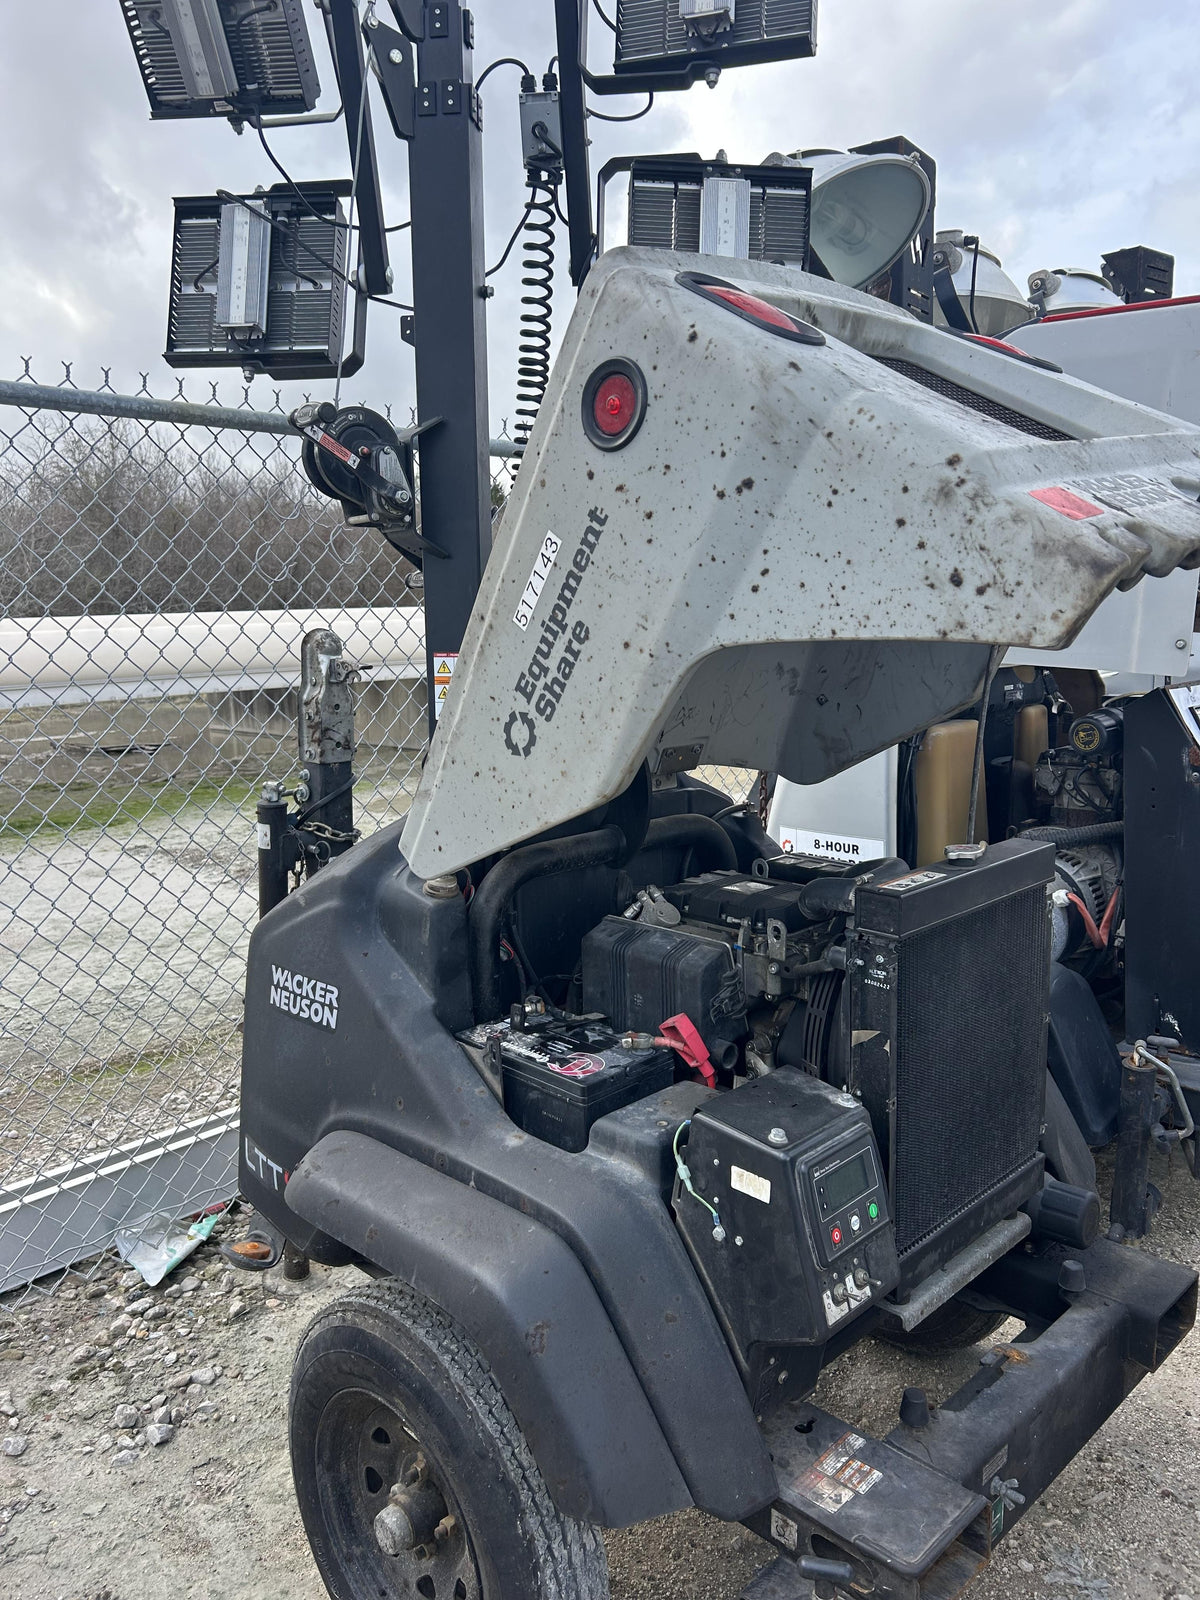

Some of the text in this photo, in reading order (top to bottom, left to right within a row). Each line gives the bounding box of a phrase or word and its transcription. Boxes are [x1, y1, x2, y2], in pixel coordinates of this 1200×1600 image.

[514, 505, 610, 705] Equipment
[515, 536, 559, 627] 517143
[534, 619, 590, 723] Share
[814, 839, 859, 855] 8-HOUR
[269, 985, 338, 1030] NEUSON
[271, 964, 339, 1008] WACKER
